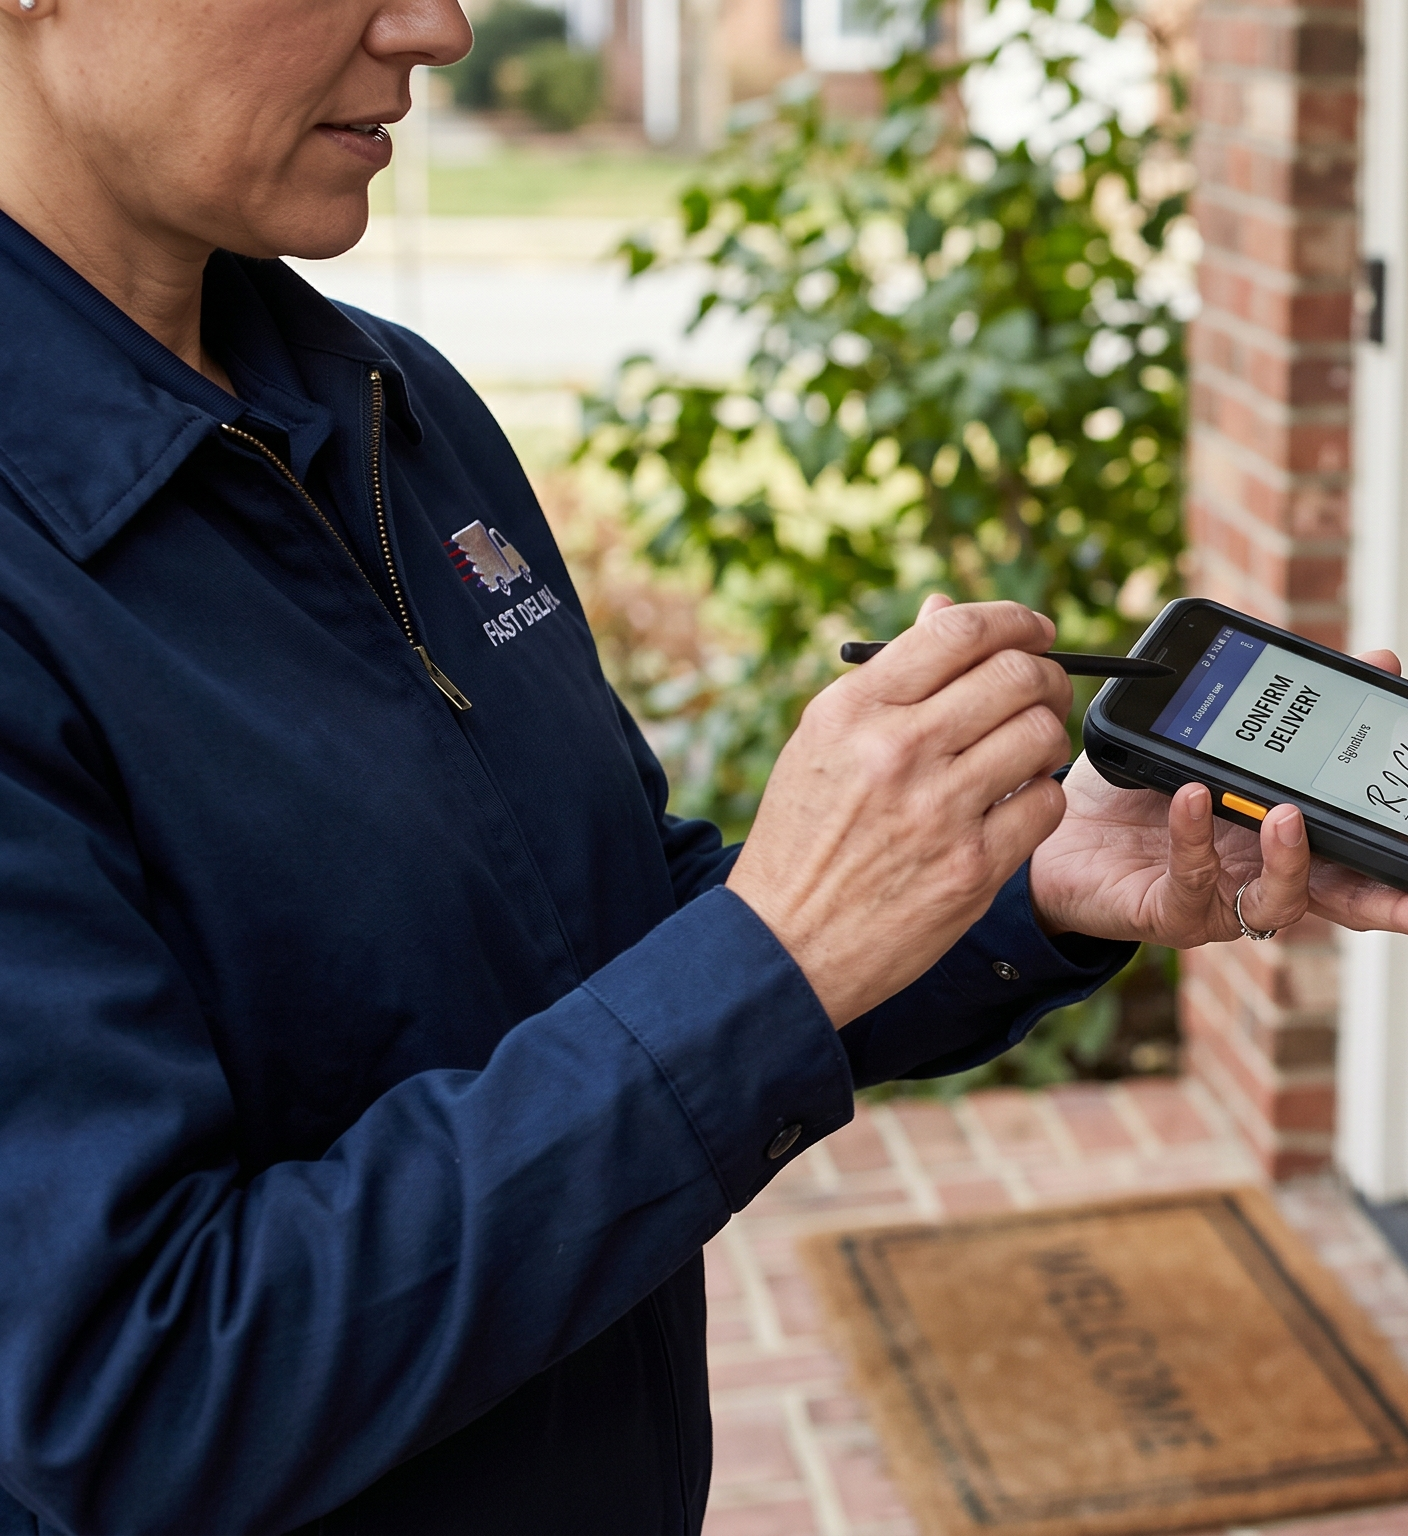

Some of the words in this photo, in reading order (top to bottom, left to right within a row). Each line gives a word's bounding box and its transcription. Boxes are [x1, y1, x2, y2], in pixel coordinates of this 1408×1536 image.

[483, 608, 523, 647] FAST
[1235, 674, 1294, 743] CONFIRM
[1264, 684, 1322, 753] DELIVERY
